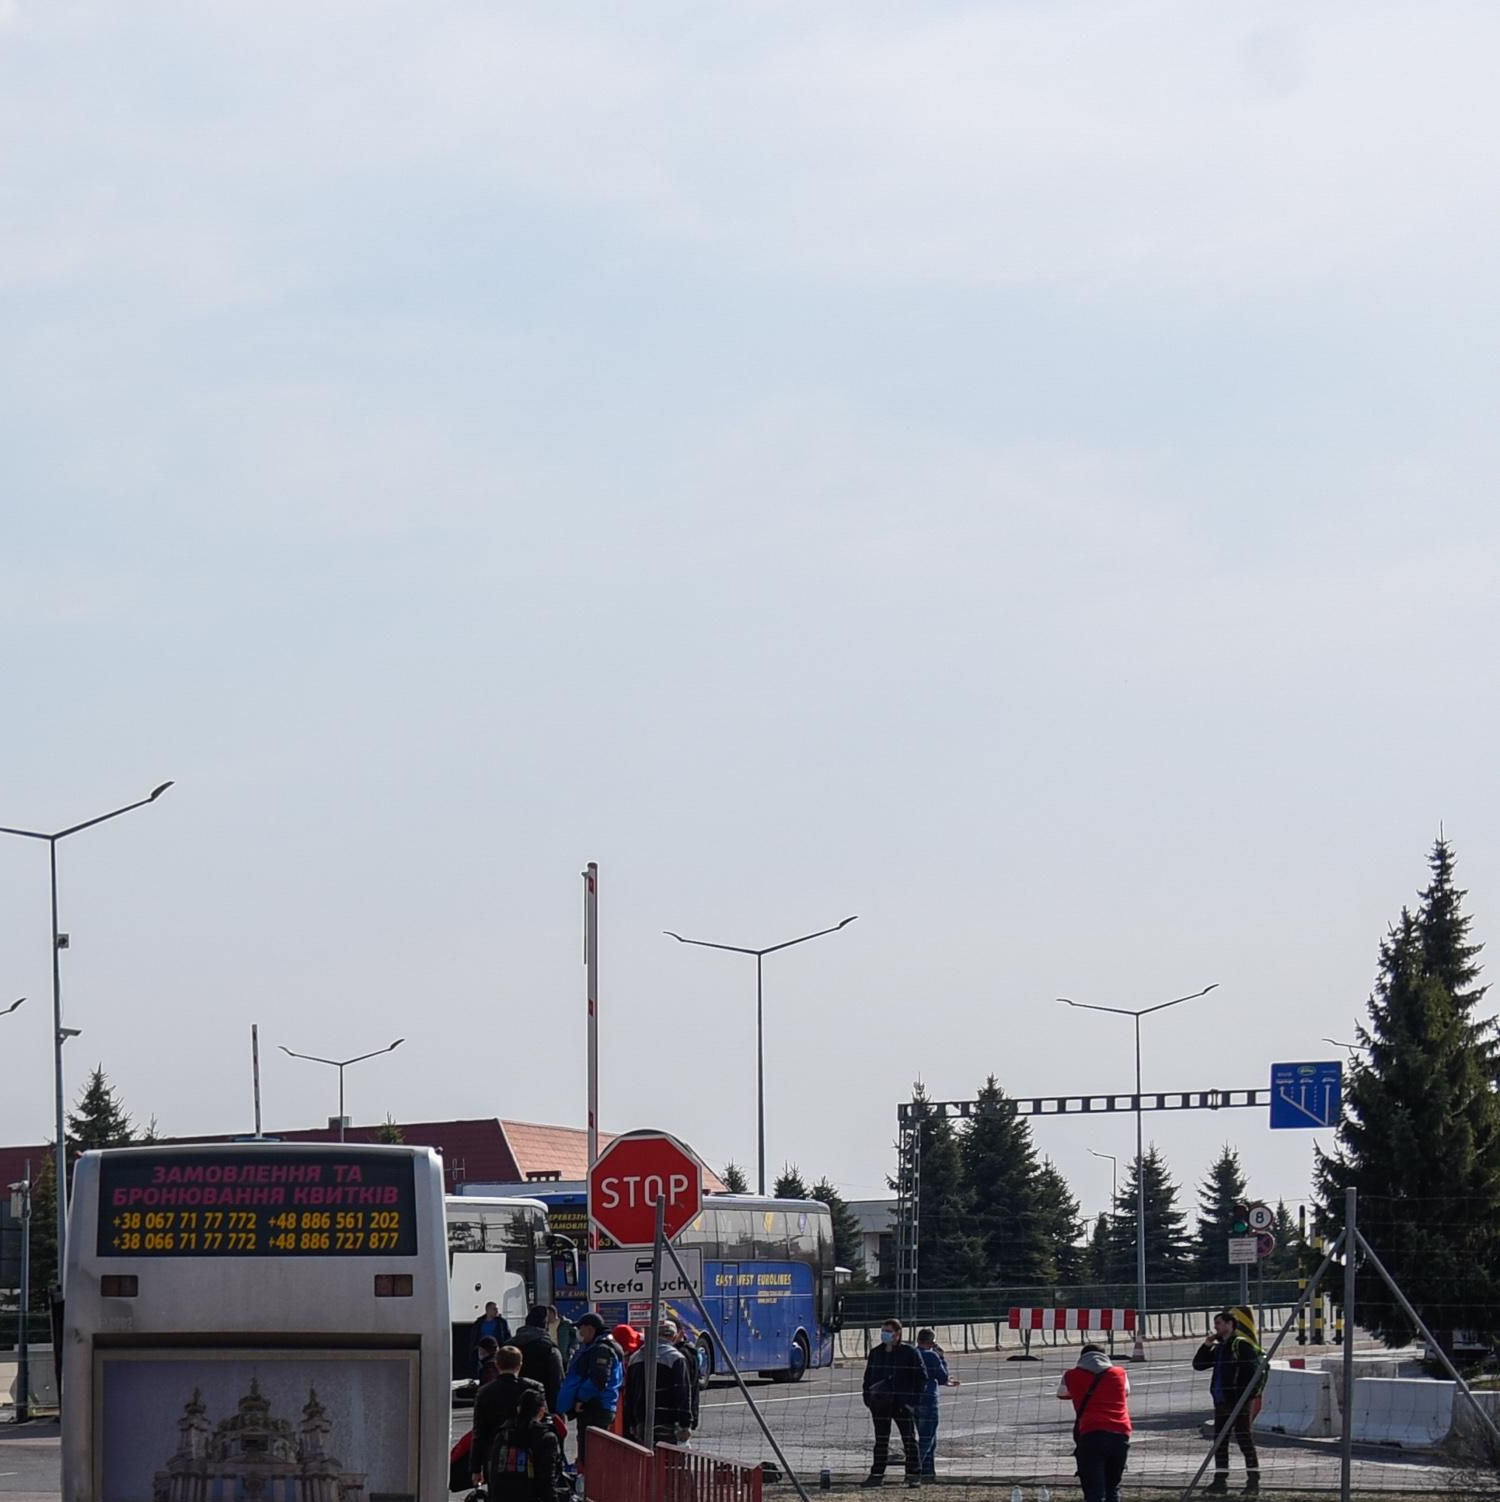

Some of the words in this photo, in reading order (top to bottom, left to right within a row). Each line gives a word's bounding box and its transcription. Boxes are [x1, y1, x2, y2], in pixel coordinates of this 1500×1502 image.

[151, 1164, 322, 1184] ЗАМОВЛЕННЯ
[333, 1164, 363, 1183] ТА
[112, 1186, 286, 1206] БРОНЮВАННЯ
[293, 1186, 399, 1205] КВИТКІВ
[601, 1174, 689, 1209] STOP
[112, 1212, 141, 1230] +38
[145, 1212, 175, 1230] 067
[180, 1212, 197, 1230] 71
[204, 1212, 223, 1230] 77
[228, 1212, 257, 1230] 772
[268, 1211, 297, 1229] +48
[301, 1211, 331, 1229] 886
[336, 1211, 364, 1229] 561
[369, 1211, 400, 1229] 202
[1255, 1211, 1265, 1224] 8
[112, 1232, 141, 1249] +38
[144, 1232, 174, 1249] 066
[180, 1232, 197, 1249] 71
[203, 1232, 223, 1249] 77
[228, 1232, 256, 1249] 772
[268, 1232, 296, 1249] +48
[300, 1232, 330, 1249] 886
[335, 1232, 364, 1249] 727
[369, 1232, 399, 1249] 877
[594, 1278, 644, 1294] Strefa
[660, 1276, 698, 1291] uch
[715, 1273, 733, 1287] EAST
[736, 1273, 754, 1287] WEST
